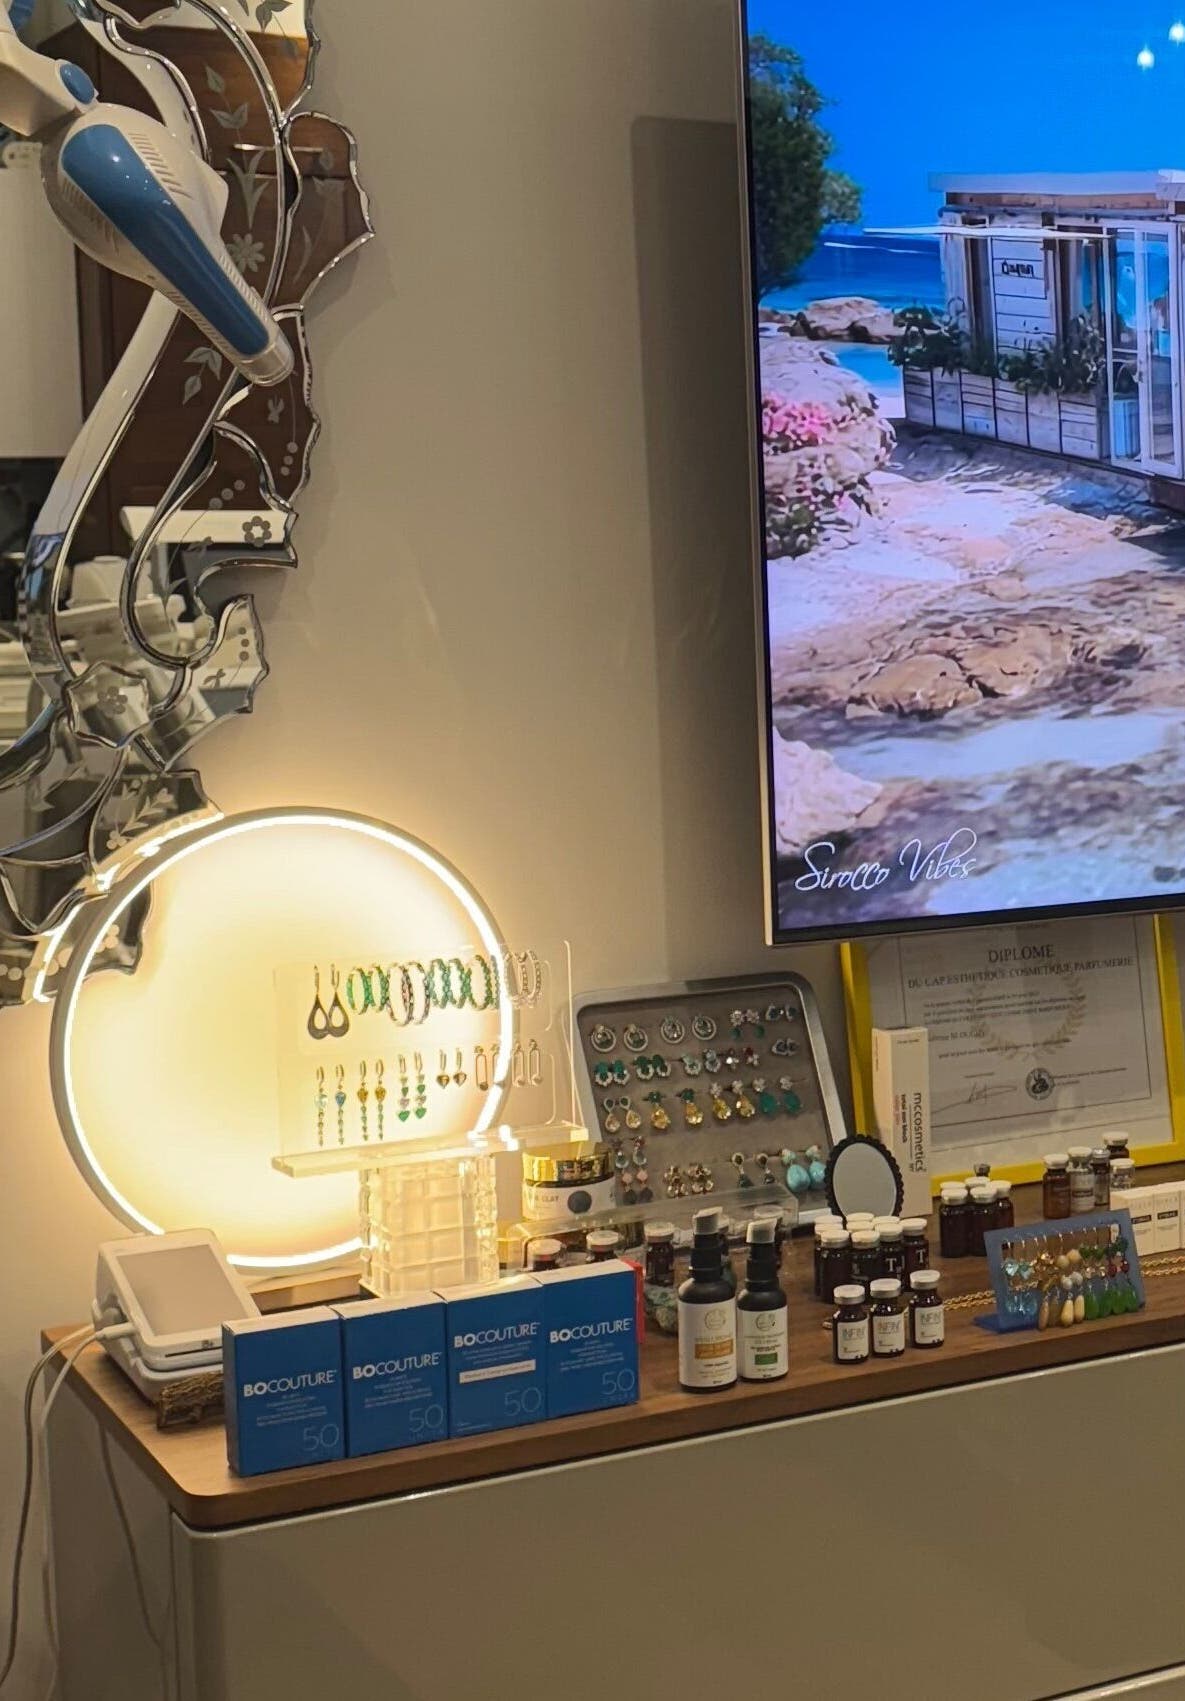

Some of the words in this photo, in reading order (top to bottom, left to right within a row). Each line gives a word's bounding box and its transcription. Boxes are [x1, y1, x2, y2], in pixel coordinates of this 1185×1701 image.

[795, 842, 890, 891] Sirocco
[899, 827, 978, 882] Vibes
[913, 1092, 926, 1172] mccosmetics
[454, 1322, 539, 1349] BOCOUTURE
[550, 1318, 632, 1344] BOCOUTURE
[352, 1352, 441, 1380] BOCOUTURE
[243, 1370, 336, 1398] BOCOUTURE
[601, 1367, 636, 1396] 50
[503, 1386, 542, 1417] 50
[408, 1403, 444, 1432] 50
[302, 1423, 340, 1453] 50
